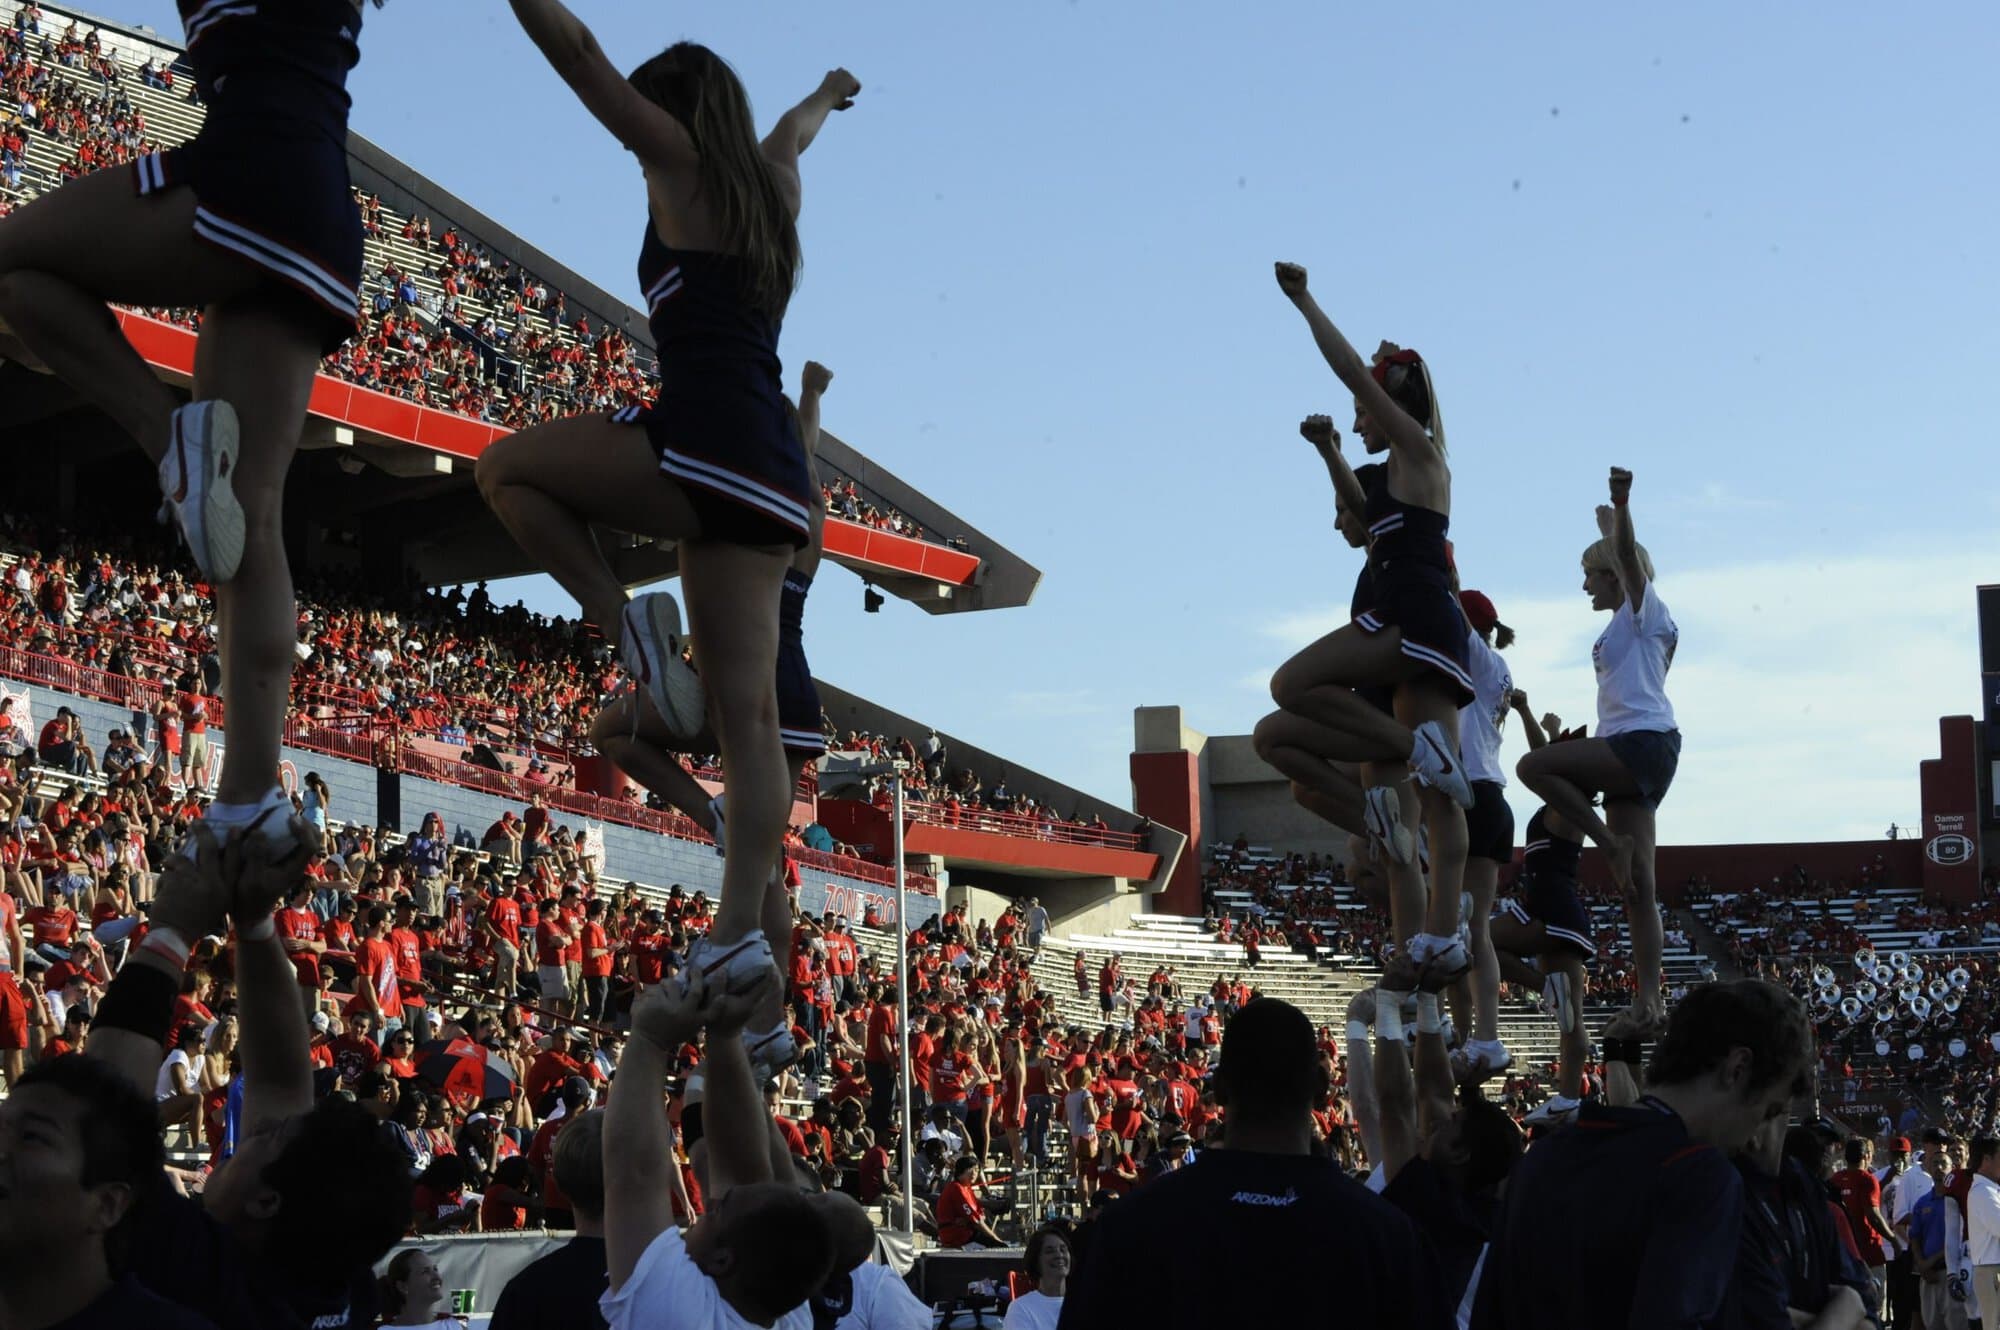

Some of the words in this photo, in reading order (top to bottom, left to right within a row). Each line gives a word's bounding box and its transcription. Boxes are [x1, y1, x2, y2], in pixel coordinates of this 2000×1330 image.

[1934, 814, 1964, 823] Damon
[1937, 823, 1963, 831] Terrell
[1944, 846, 1957, 854] 80
[1845, 1104, 1870, 1114] SECTION
[1231, 1192, 1288, 1206] ARIZONA
[311, 1313, 350, 1330] ARIZO
